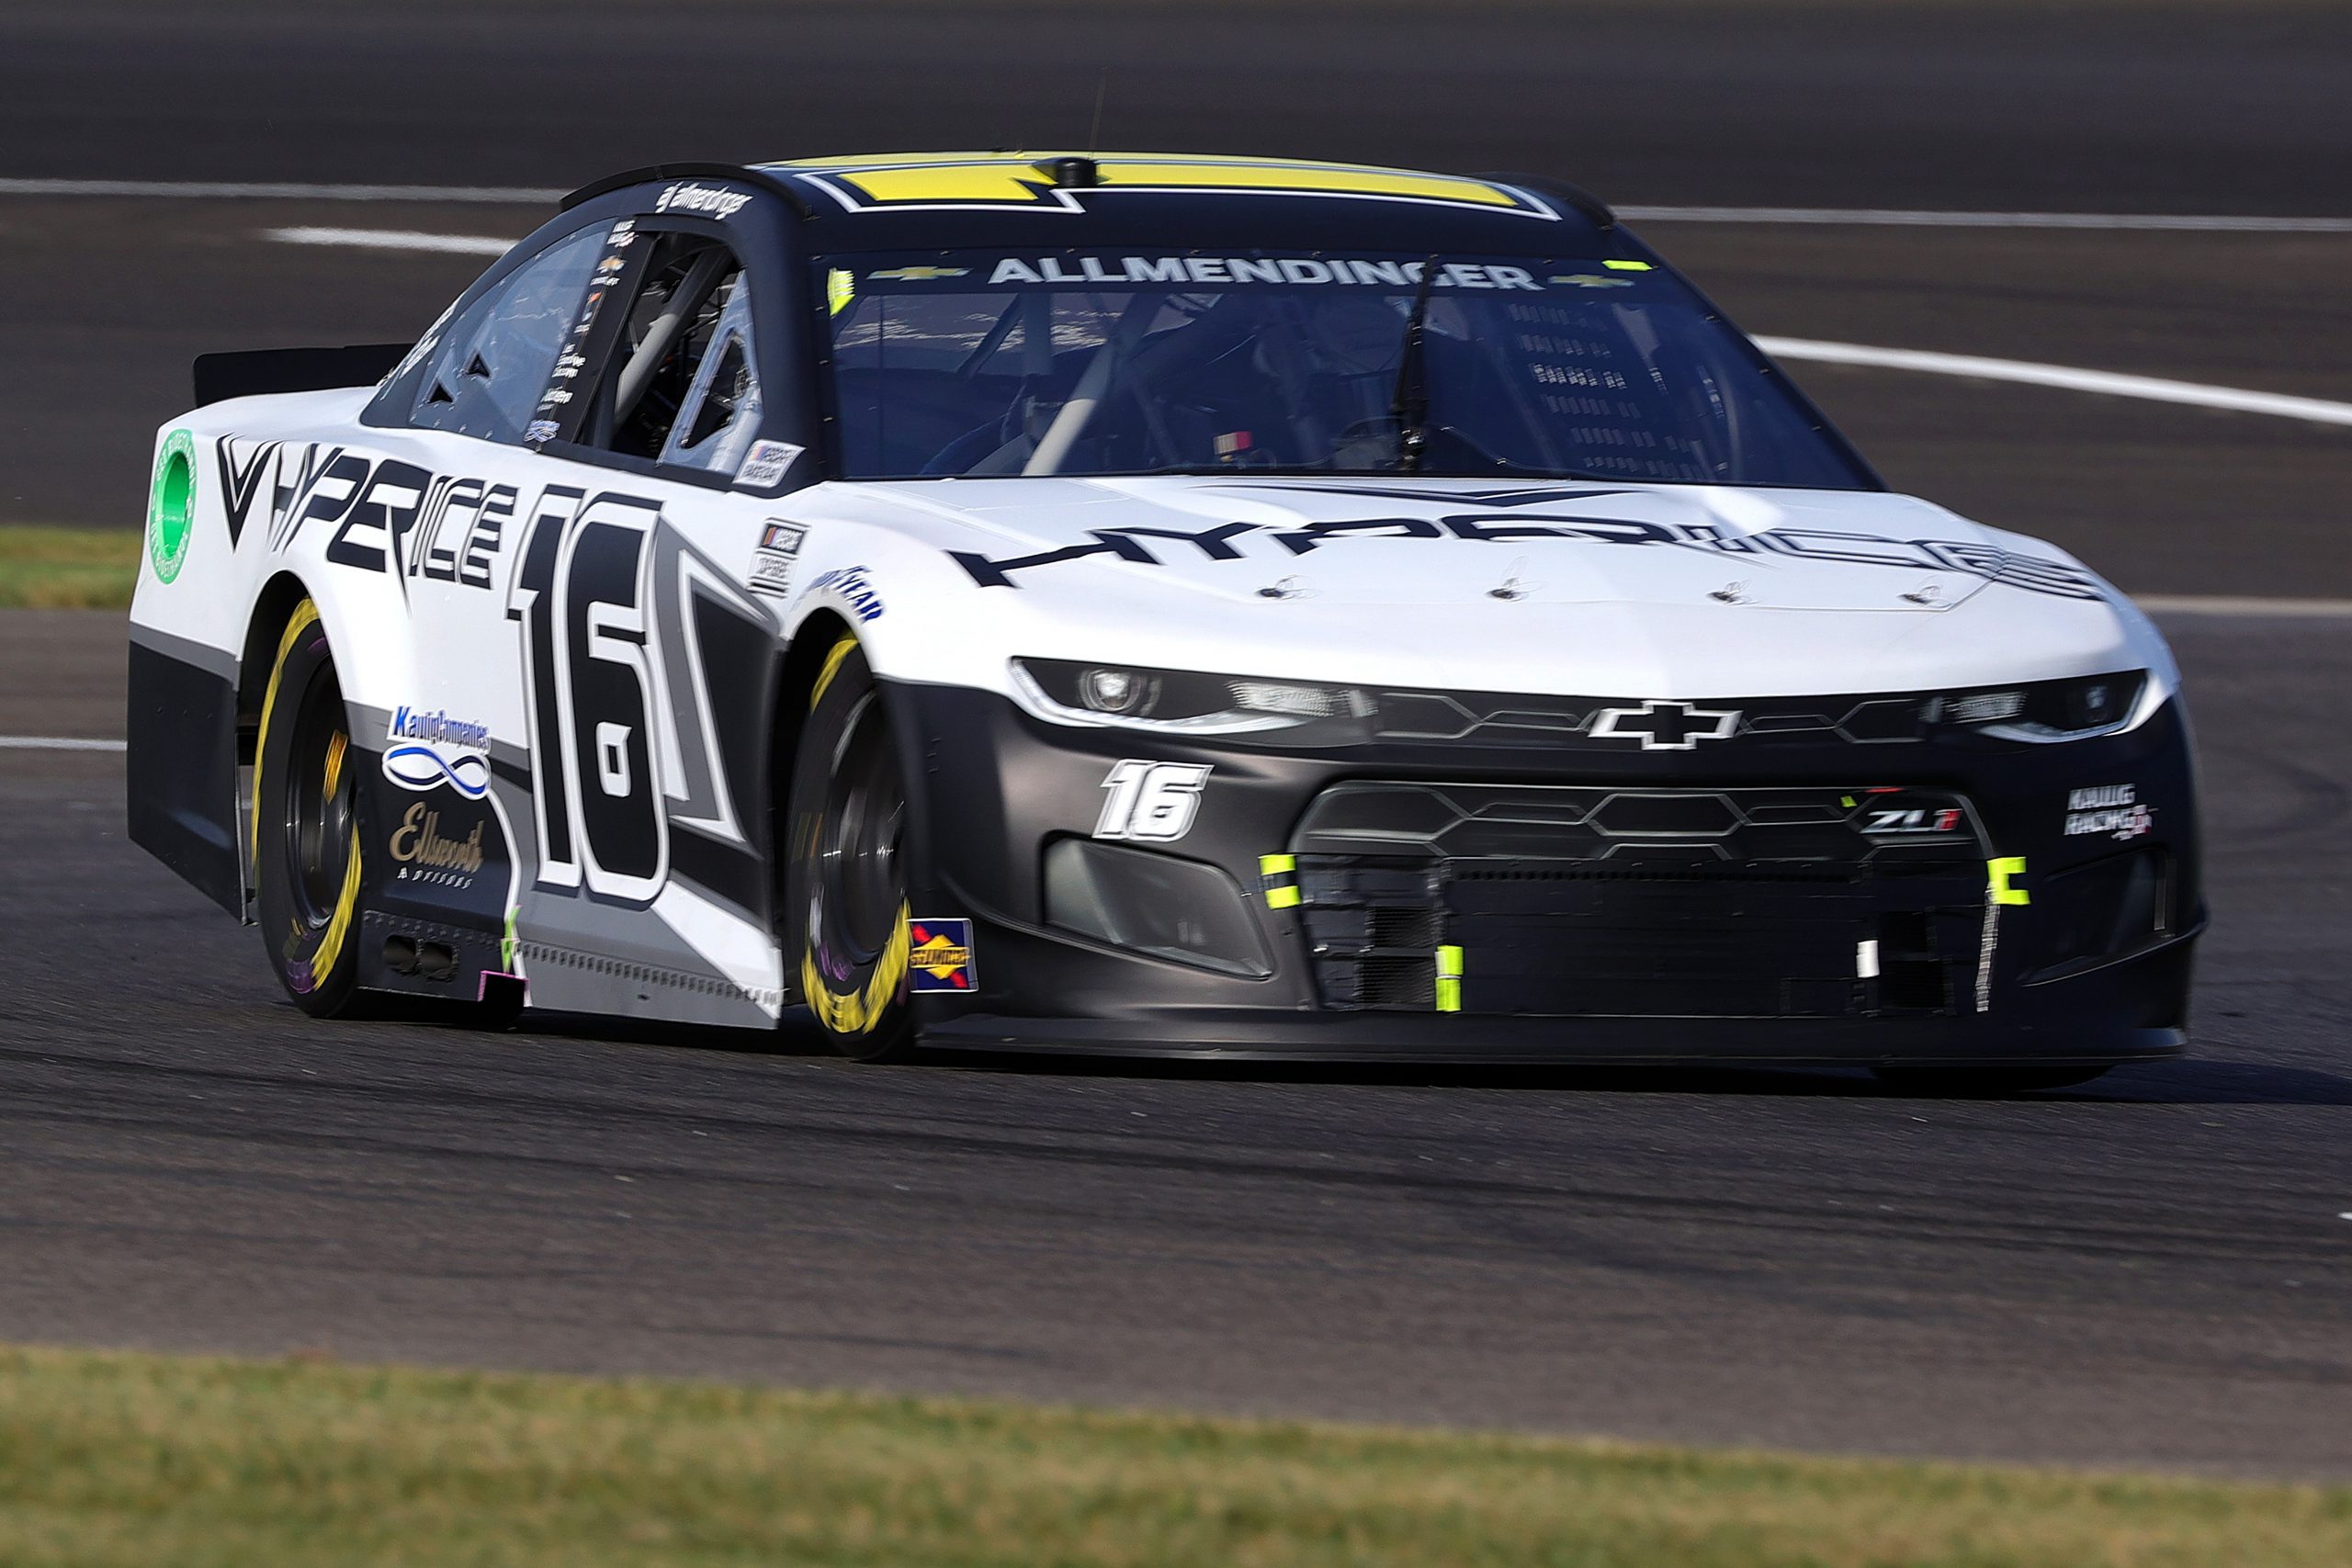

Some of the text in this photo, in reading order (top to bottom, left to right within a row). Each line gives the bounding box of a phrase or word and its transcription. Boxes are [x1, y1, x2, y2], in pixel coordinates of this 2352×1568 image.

[988, 256, 1546, 291] ALLMENDINGER
[506, 483, 668, 911] 16
[1091, 758, 1215, 842] 16
[1859, 808, 1963, 834] ZL1
